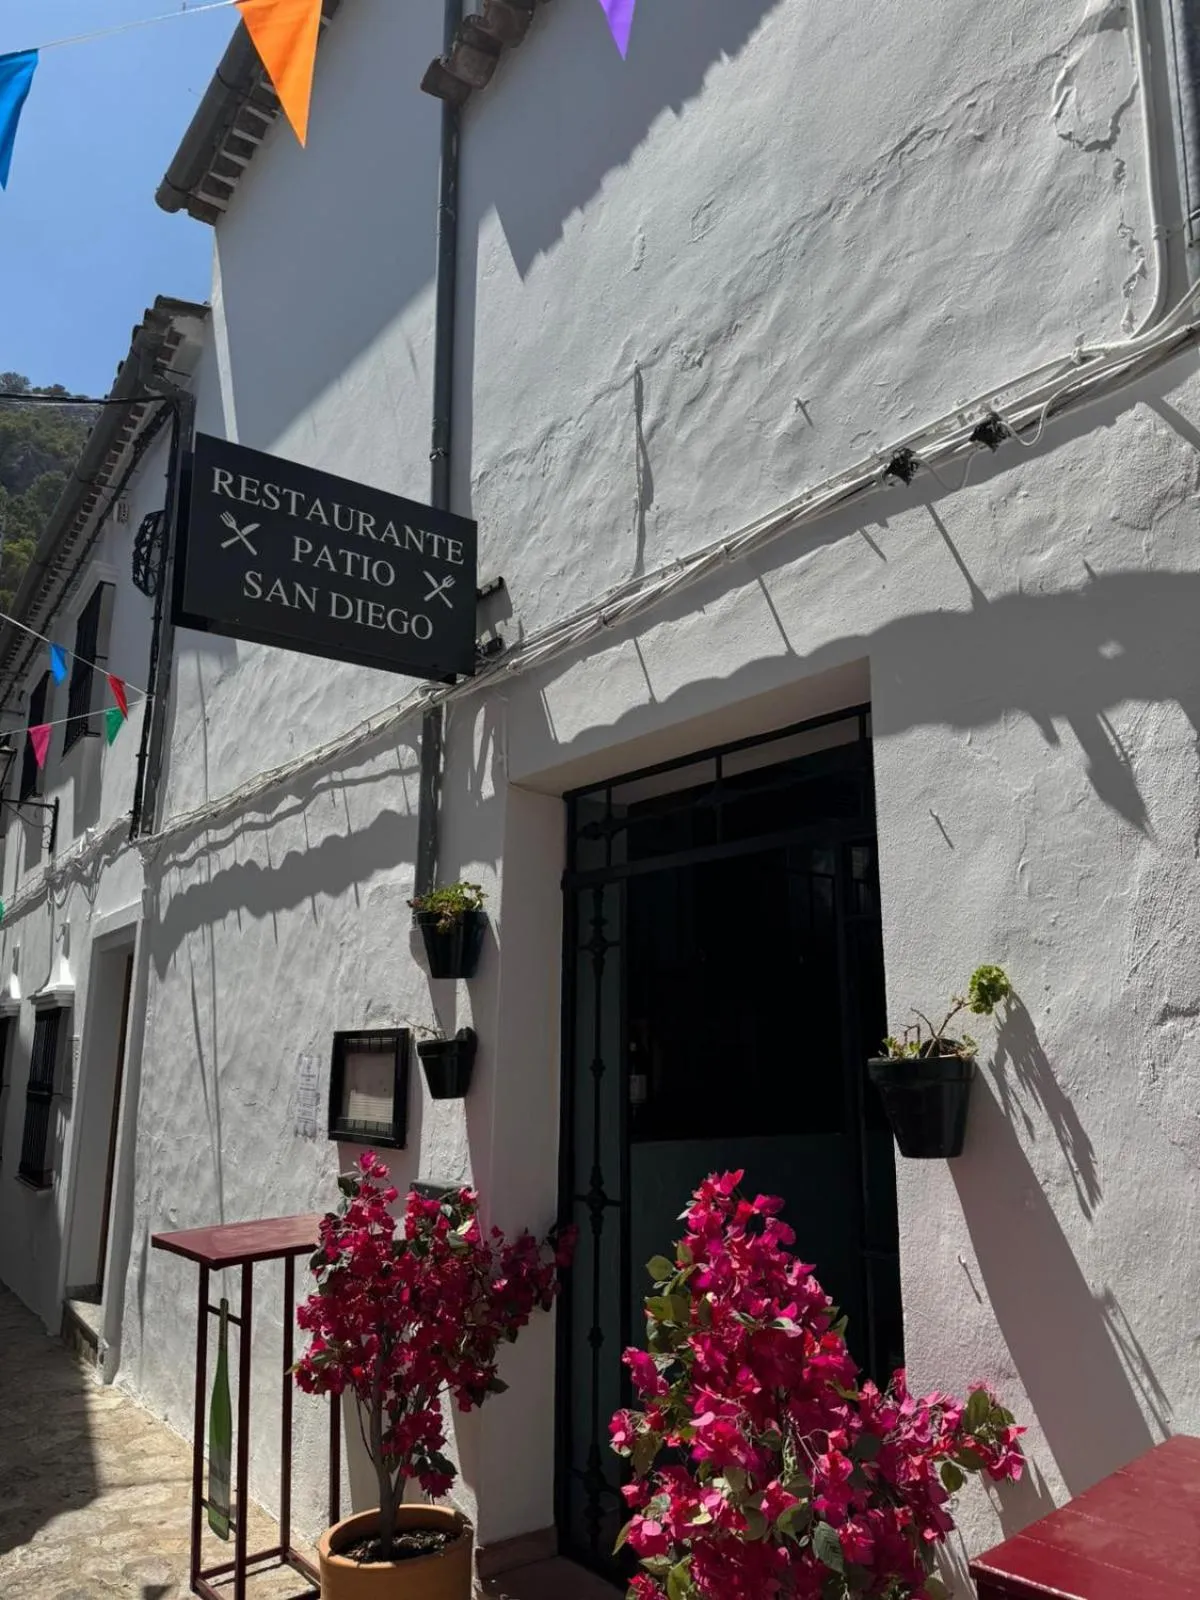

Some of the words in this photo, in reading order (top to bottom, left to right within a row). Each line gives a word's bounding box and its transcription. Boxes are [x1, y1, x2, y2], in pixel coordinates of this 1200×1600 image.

[211, 466, 465, 566] RESTAURANTE
[292, 535, 396, 588] PATIO
[243, 570, 319, 613] SAN
[329, 591, 434, 640] DIEGO
